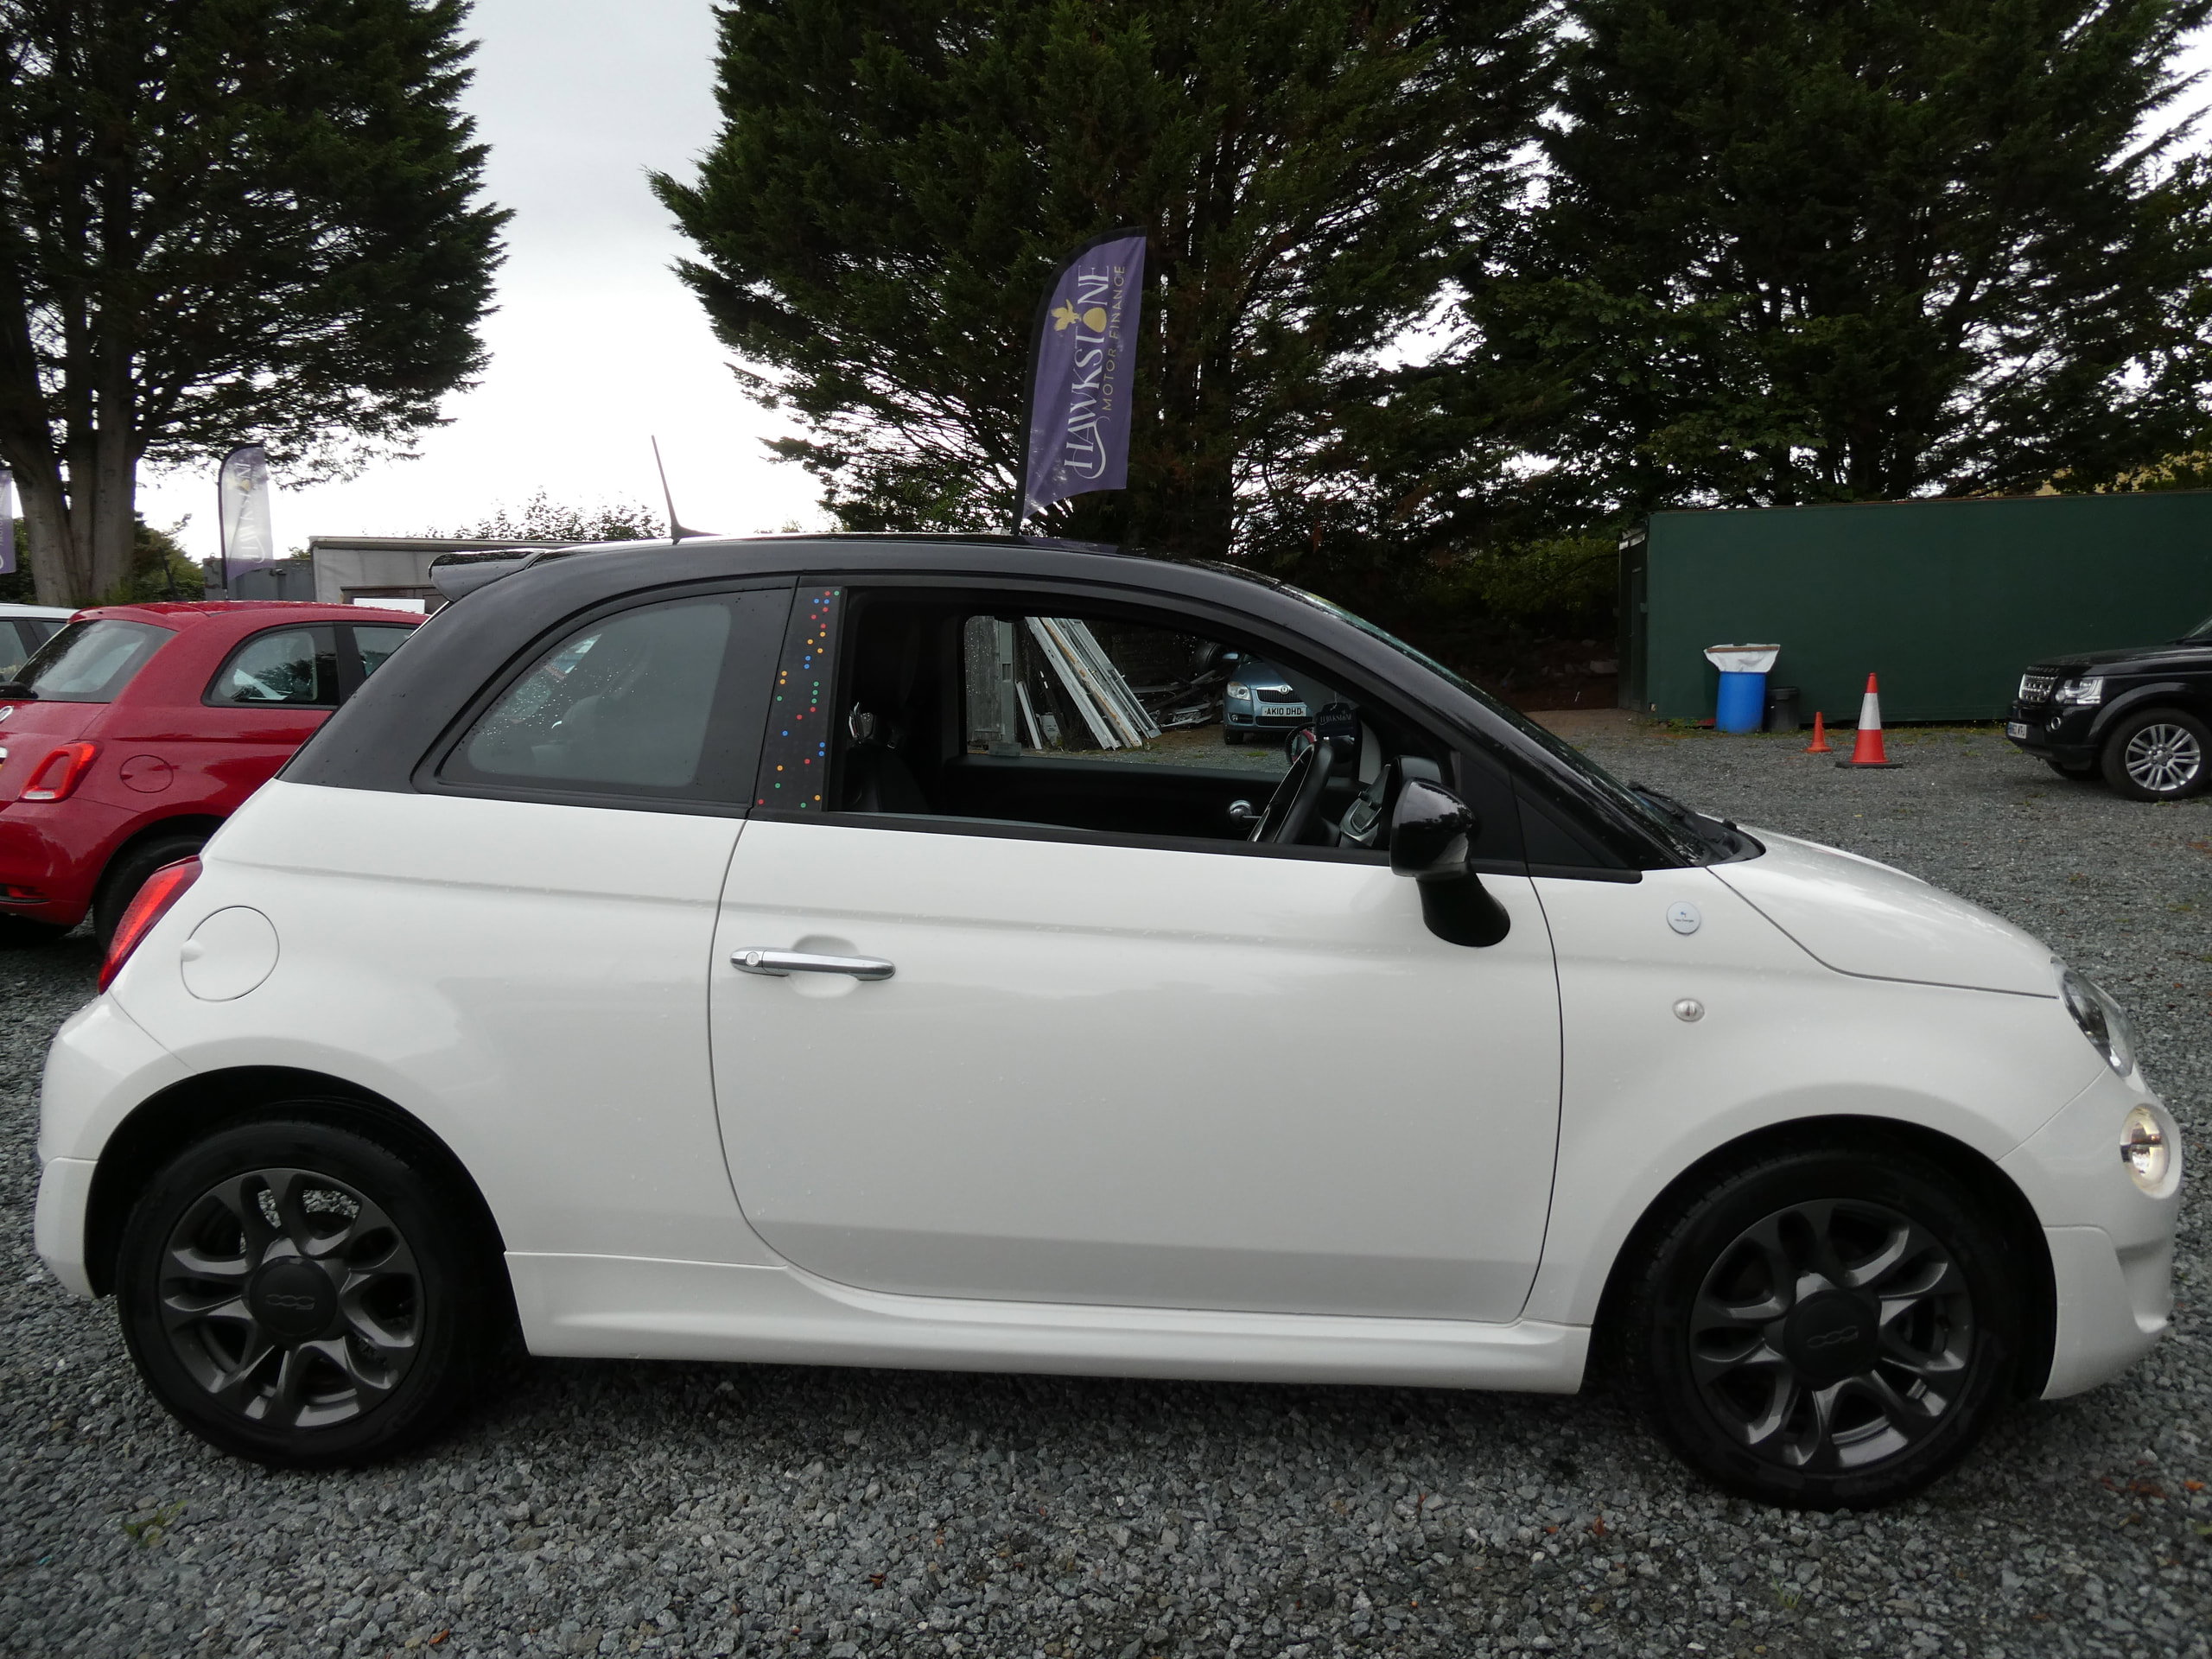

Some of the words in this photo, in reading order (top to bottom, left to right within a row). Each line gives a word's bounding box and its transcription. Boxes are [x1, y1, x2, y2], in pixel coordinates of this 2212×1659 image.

[1064, 264, 1110, 479] HAWKSTONE
[1102, 348, 1116, 411] MOTOR
[1109, 265, 1126, 340] FINANCE
